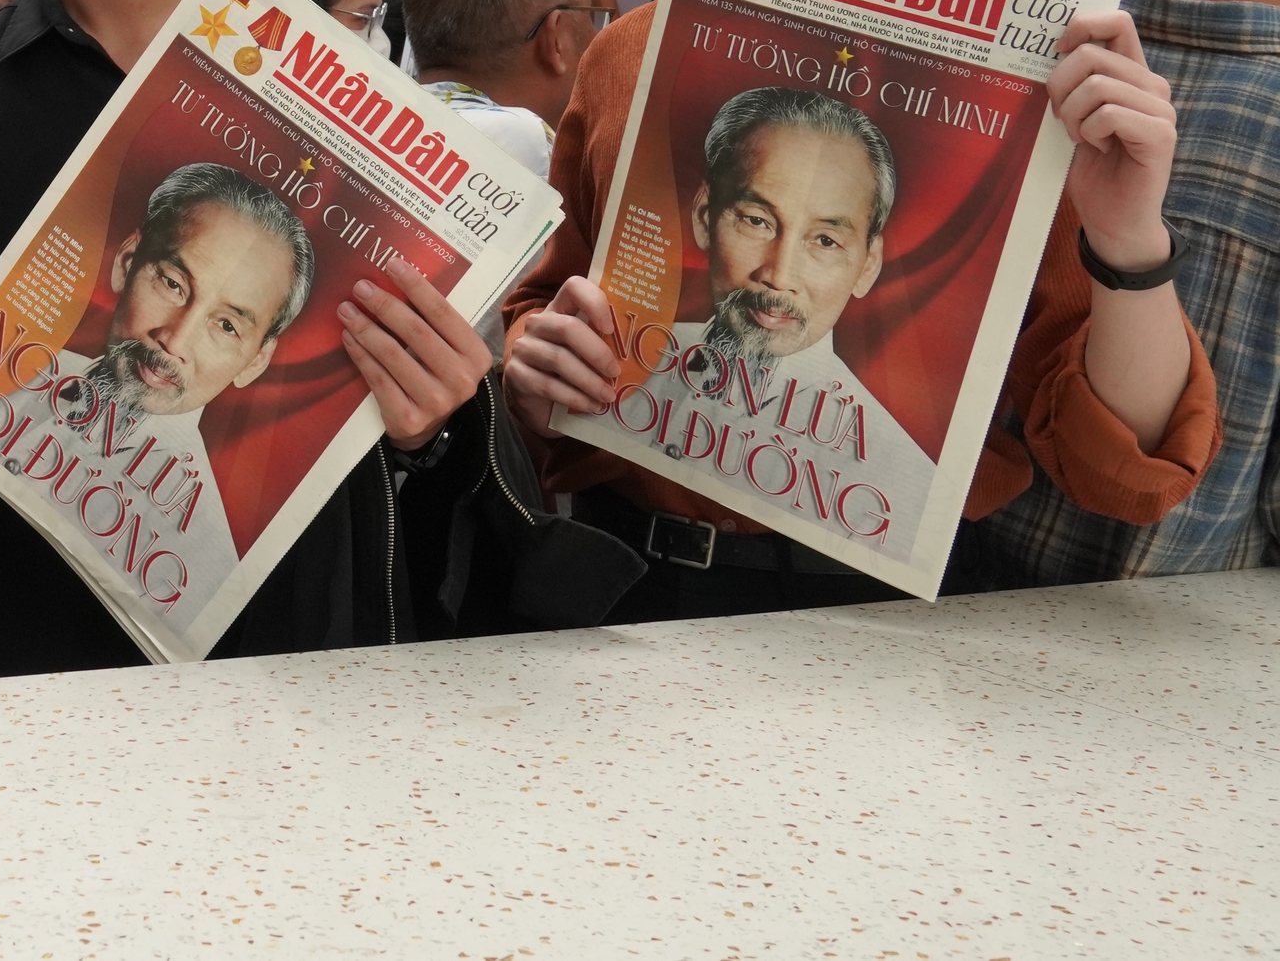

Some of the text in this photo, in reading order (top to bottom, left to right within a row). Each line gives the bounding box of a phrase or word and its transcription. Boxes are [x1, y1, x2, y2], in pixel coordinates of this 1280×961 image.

[279, 30, 470, 195] Nhân Dân
[691, 22, 1011, 140] TƯ TƯỞNG HỒ CHÍ MINH
[170, 79, 427, 278] TƯ TƯỞNG HỒ CHÍ MI
[445, 191, 499, 244] tuần
[467, 172, 525, 218] cuối
[681, 409, 891, 545] ĐƯỜNG
[778, 377, 867, 461] LỬA
[22, 433, 189, 614] ĐƯỜNG
[124, 435, 204, 534] LỬA
